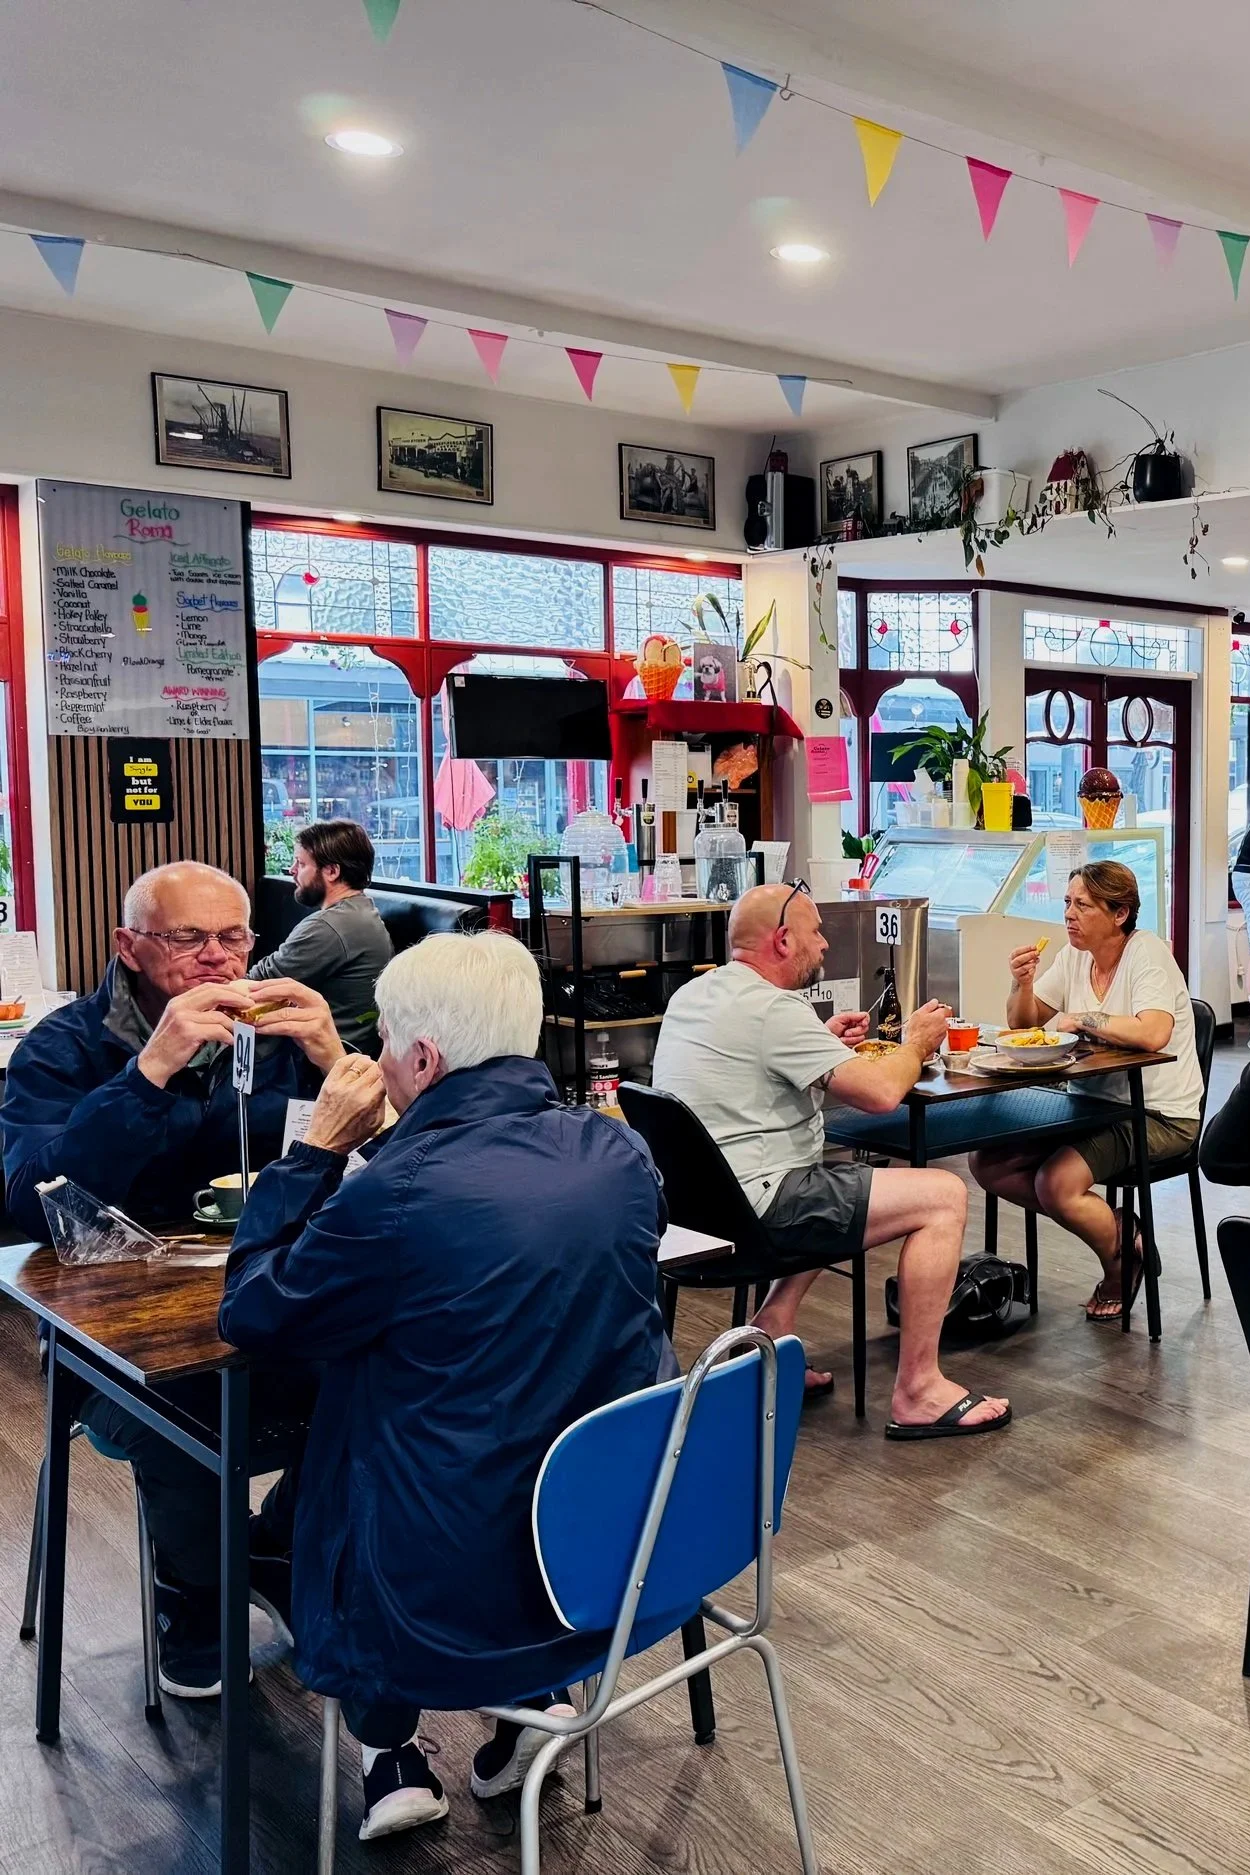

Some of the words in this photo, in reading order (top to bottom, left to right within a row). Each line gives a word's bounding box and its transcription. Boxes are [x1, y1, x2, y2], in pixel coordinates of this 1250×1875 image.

[120, 499, 180, 520] Gelato
[126, 518, 173, 539] Roma
[56, 543, 89, 559] Gelato
[79, 566, 117, 578] Chocolate
[55, 578, 85, 589] Salted
[87, 580, 118, 590] Caramel
[56, 588, 88, 599] Vanilla
[57, 599, 91, 609] Coconut
[181, 611, 208, 622] Lemon
[181, 621, 201, 631] Lime
[59, 633, 106, 648] Strawberry
[180, 630, 207, 641] Mango
[60, 674, 111, 688] Passionfruit
[60, 687, 107, 701] Raspberry
[163, 686, 190, 696] AWARD
[192, 688, 226, 697] WINNING
[60, 700, 106, 712] Peppermint
[176, 700, 217, 713] Raspberry
[60, 713, 93, 724] Coffee
[169, 717, 186, 726] Lime
[131, 777, 152, 786] but
[143, 786, 158, 794] for
[879, 912, 899, 938] 36
